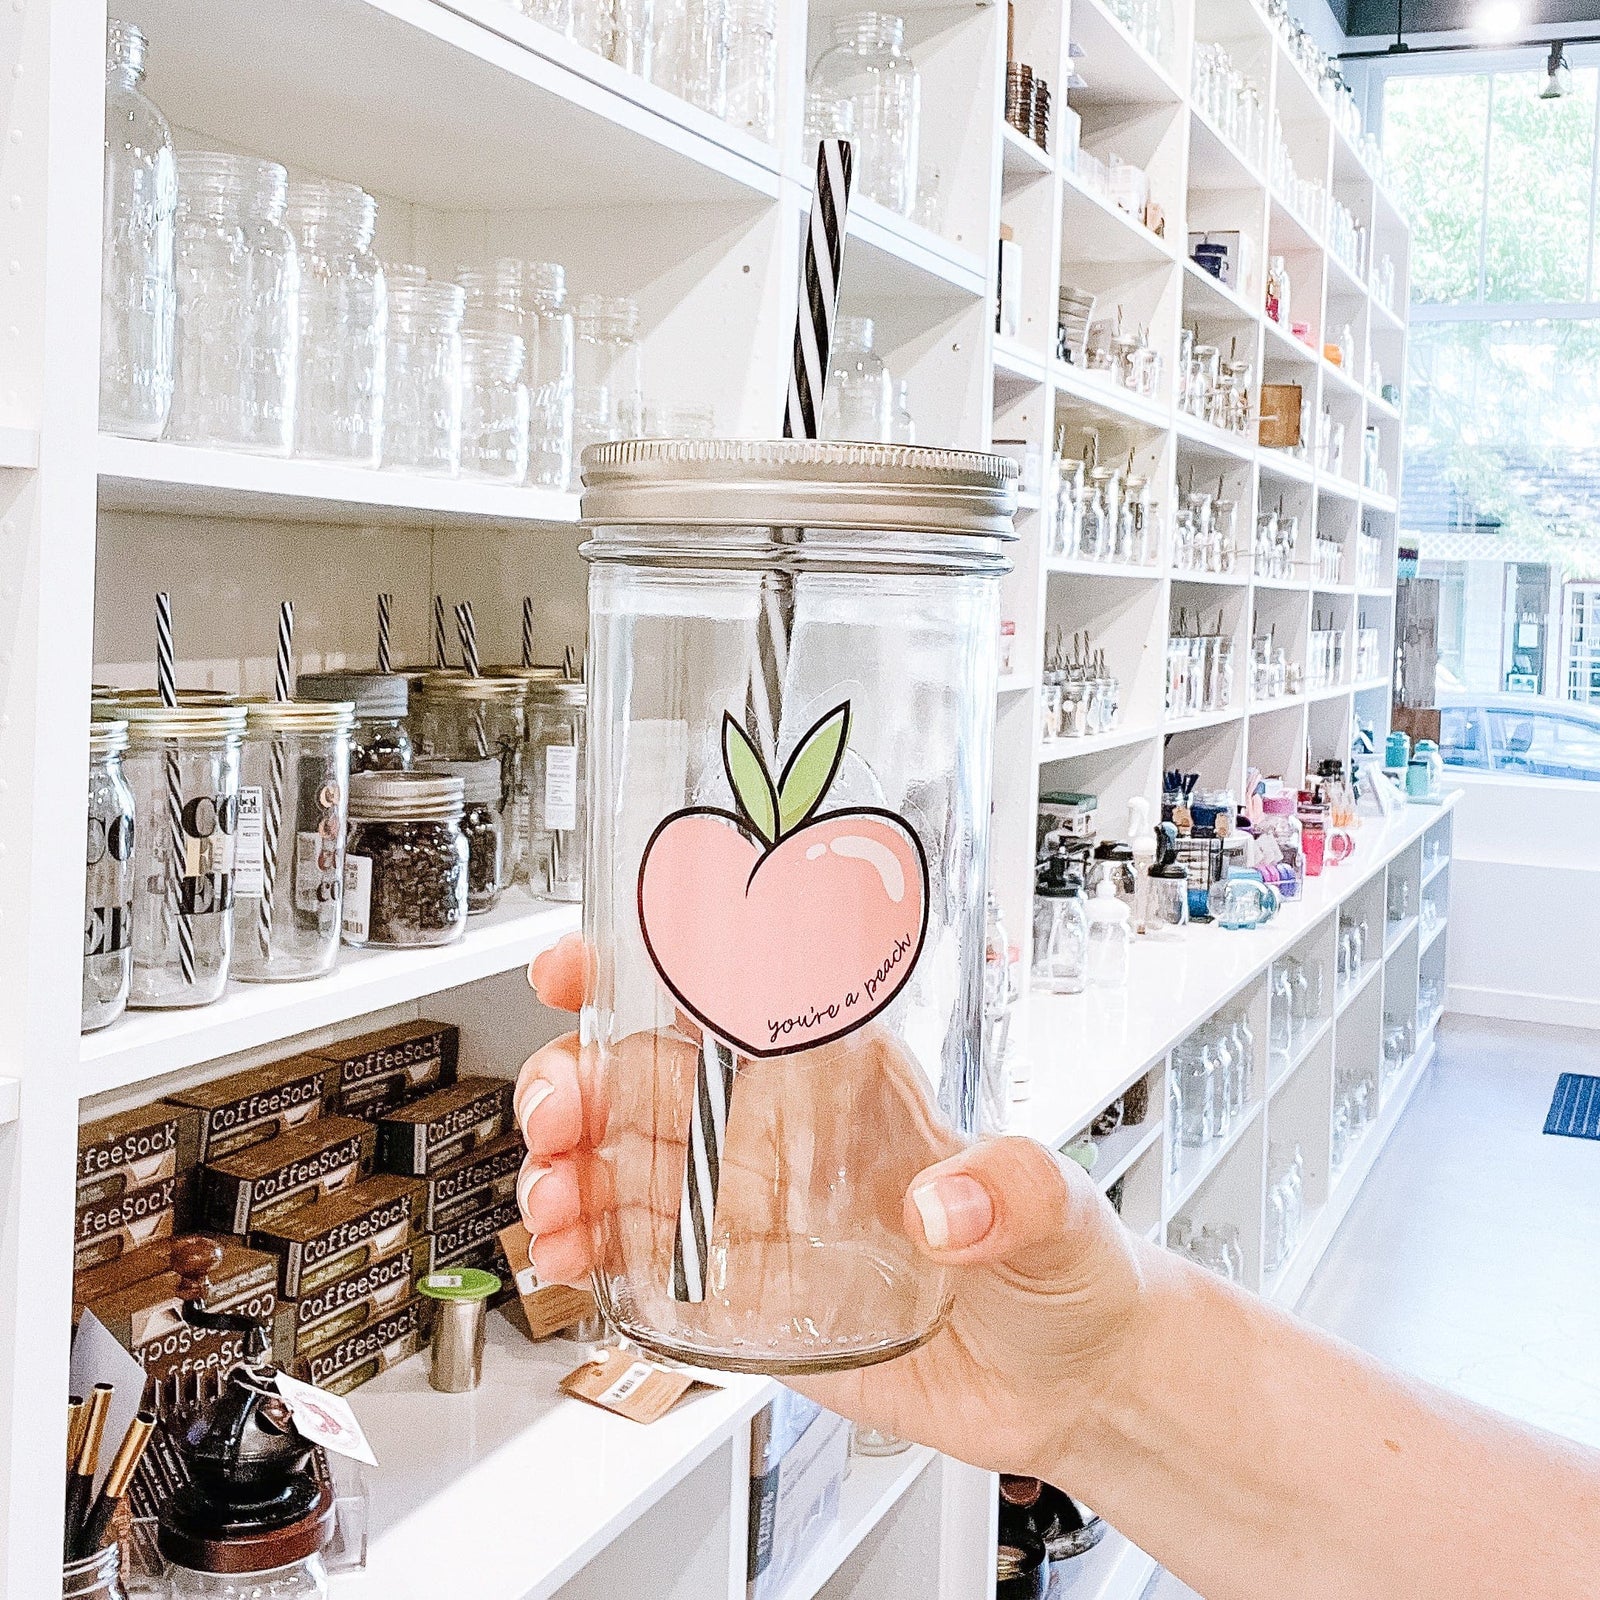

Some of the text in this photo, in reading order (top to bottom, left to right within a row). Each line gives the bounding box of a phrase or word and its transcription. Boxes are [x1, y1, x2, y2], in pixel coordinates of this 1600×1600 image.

[767, 932, 912, 1043] you're a peach
[344, 1035, 441, 1080] CoffeeSock
[212, 1073, 323, 1130] CoffeeSock
[80, 1120, 177, 1174] feeSock
[254, 1135, 361, 1201] CoffeeSock
[81, 1180, 175, 1236] feeSock
[304, 1196, 411, 1263] CoffeeSock
[437, 1205, 520, 1254] CoffeeSoc
[300, 1250, 411, 1321] CoffeeSock
[311, 1304, 418, 1382] CoffeeSock
